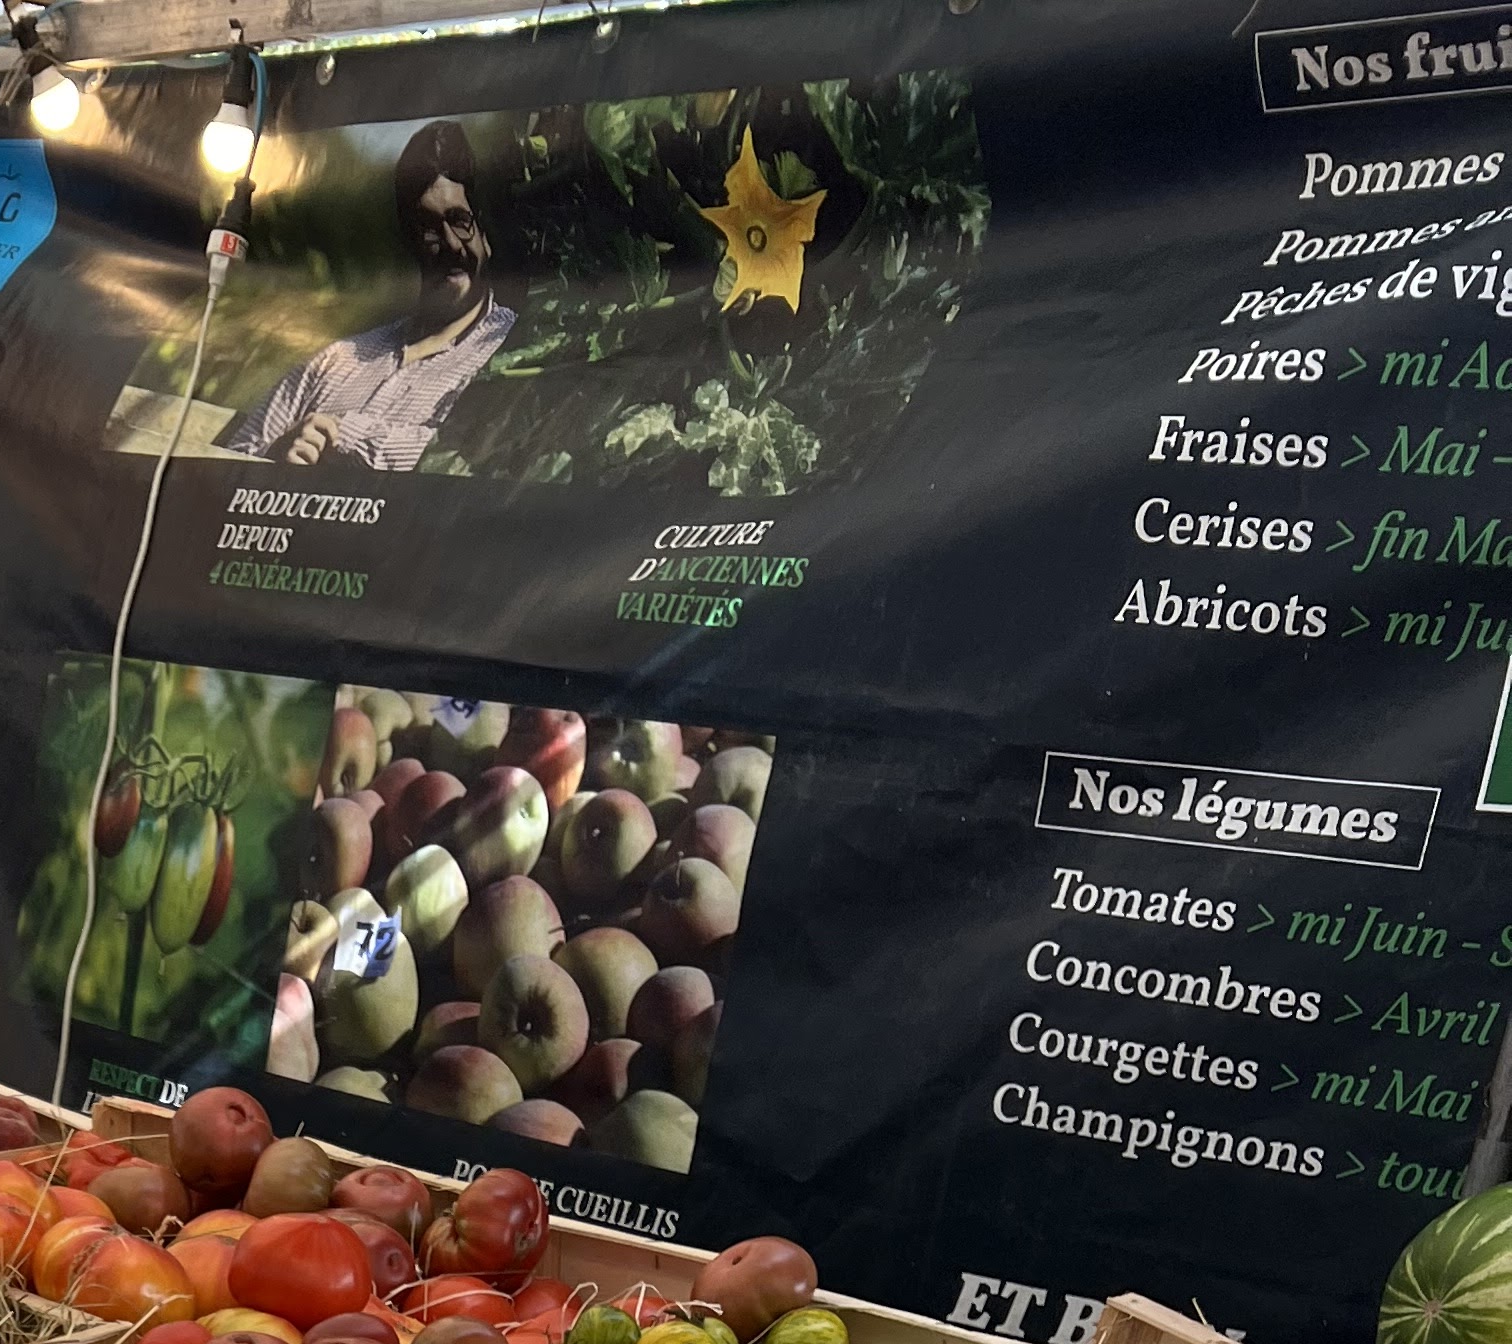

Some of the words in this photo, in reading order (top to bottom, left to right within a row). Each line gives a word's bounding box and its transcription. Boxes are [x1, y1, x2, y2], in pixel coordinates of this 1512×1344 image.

[1292, 43, 1392, 92] Nos
[1299, 151, 1505, 200] Pommes
[1263, 217, 1463, 266] Pommes
[1220, 272, 1374, 325] Pêches
[1377, 258, 1438, 300] de
[1178, 341, 1326, 383] Poires
[1380, 337, 1450, 388] mi
[1148, 414, 1329, 470] Fraises
[1378, 424, 1488, 477] Mai
[227, 488, 386, 525] PRODUCTEURS
[217, 523, 294, 554] DEPUIS
[654, 519, 775, 550] CULTURE
[1134, 497, 1315, 553] Cerises
[1352, 509, 1429, 572] fin
[209, 559, 225, 585] 4
[223, 556, 369, 600] GÉNÉRATIONS
[628, 555, 810, 589] D'ANCIENNES
[616, 587, 744, 629] VARIÉTÉS
[1114, 578, 1328, 639] Abricots
[1384, 599, 1452, 646] mi
[1068, 767, 1164, 818] Nos
[1173, 778, 1398, 844] légumes
[1050, 866, 1237, 933] Tomates
[1287, 903, 1353, 946] mi
[1342, 906, 1448, 962] Juin
[356, 921, 396, 960] 72
[1025, 939, 1322, 1024] Concombres
[1371, 991, 1501, 1046] Avril
[1008, 1011, 1260, 1091] Courgettes
[1311, 1064, 1377, 1107] mi
[1374, 1069, 1479, 1123] Mai
[158, 1078, 189, 1108] DE
[992, 1082, 1326, 1178] Champignons
[556, 1185, 680, 1239] CUEILLIS
[946, 1271, 1046, 1339] ET
